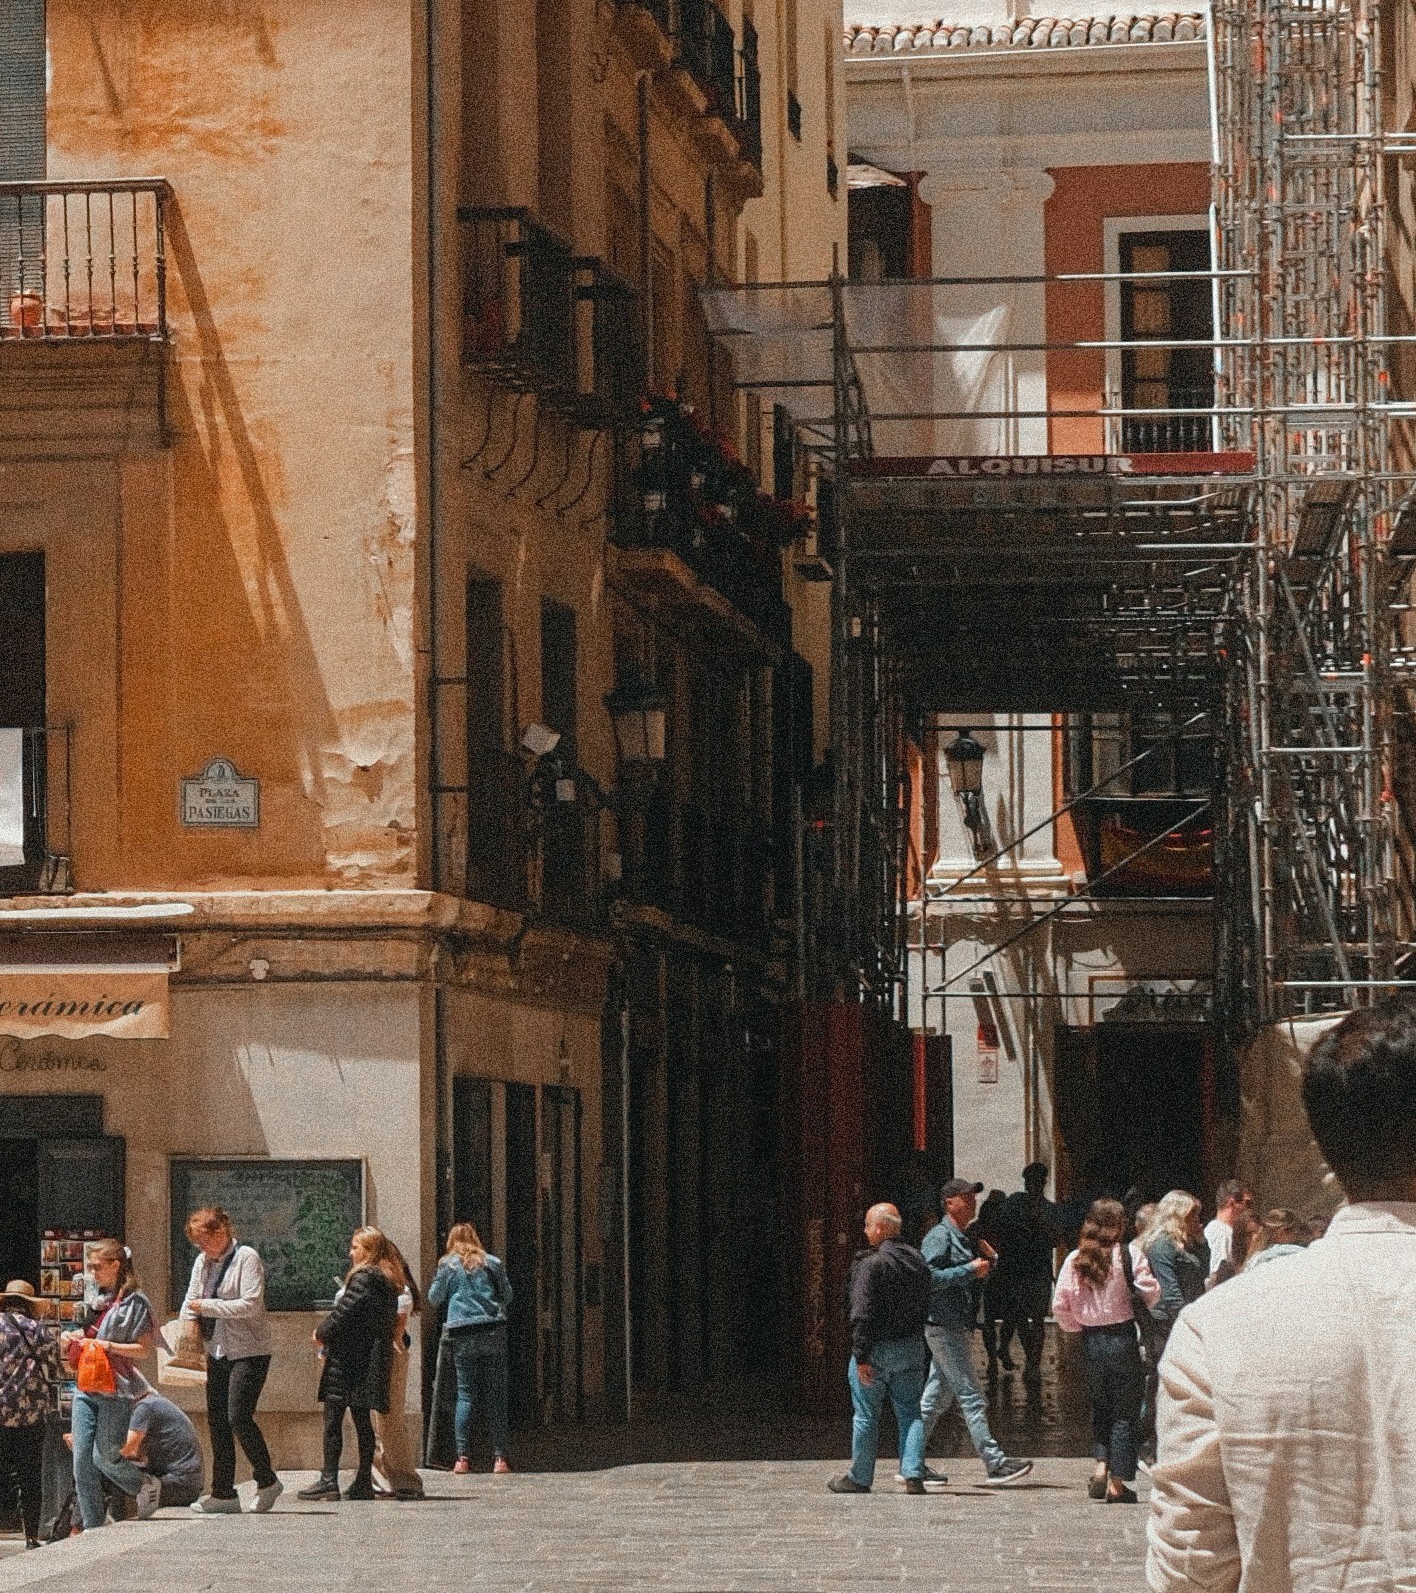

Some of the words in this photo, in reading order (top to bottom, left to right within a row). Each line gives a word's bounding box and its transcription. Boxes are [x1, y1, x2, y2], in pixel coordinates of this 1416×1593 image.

[927, 458, 1134, 475] ALQUISUR
[200, 788, 240, 798] PLAZA
[188, 806, 251, 819] PASIEGAS
